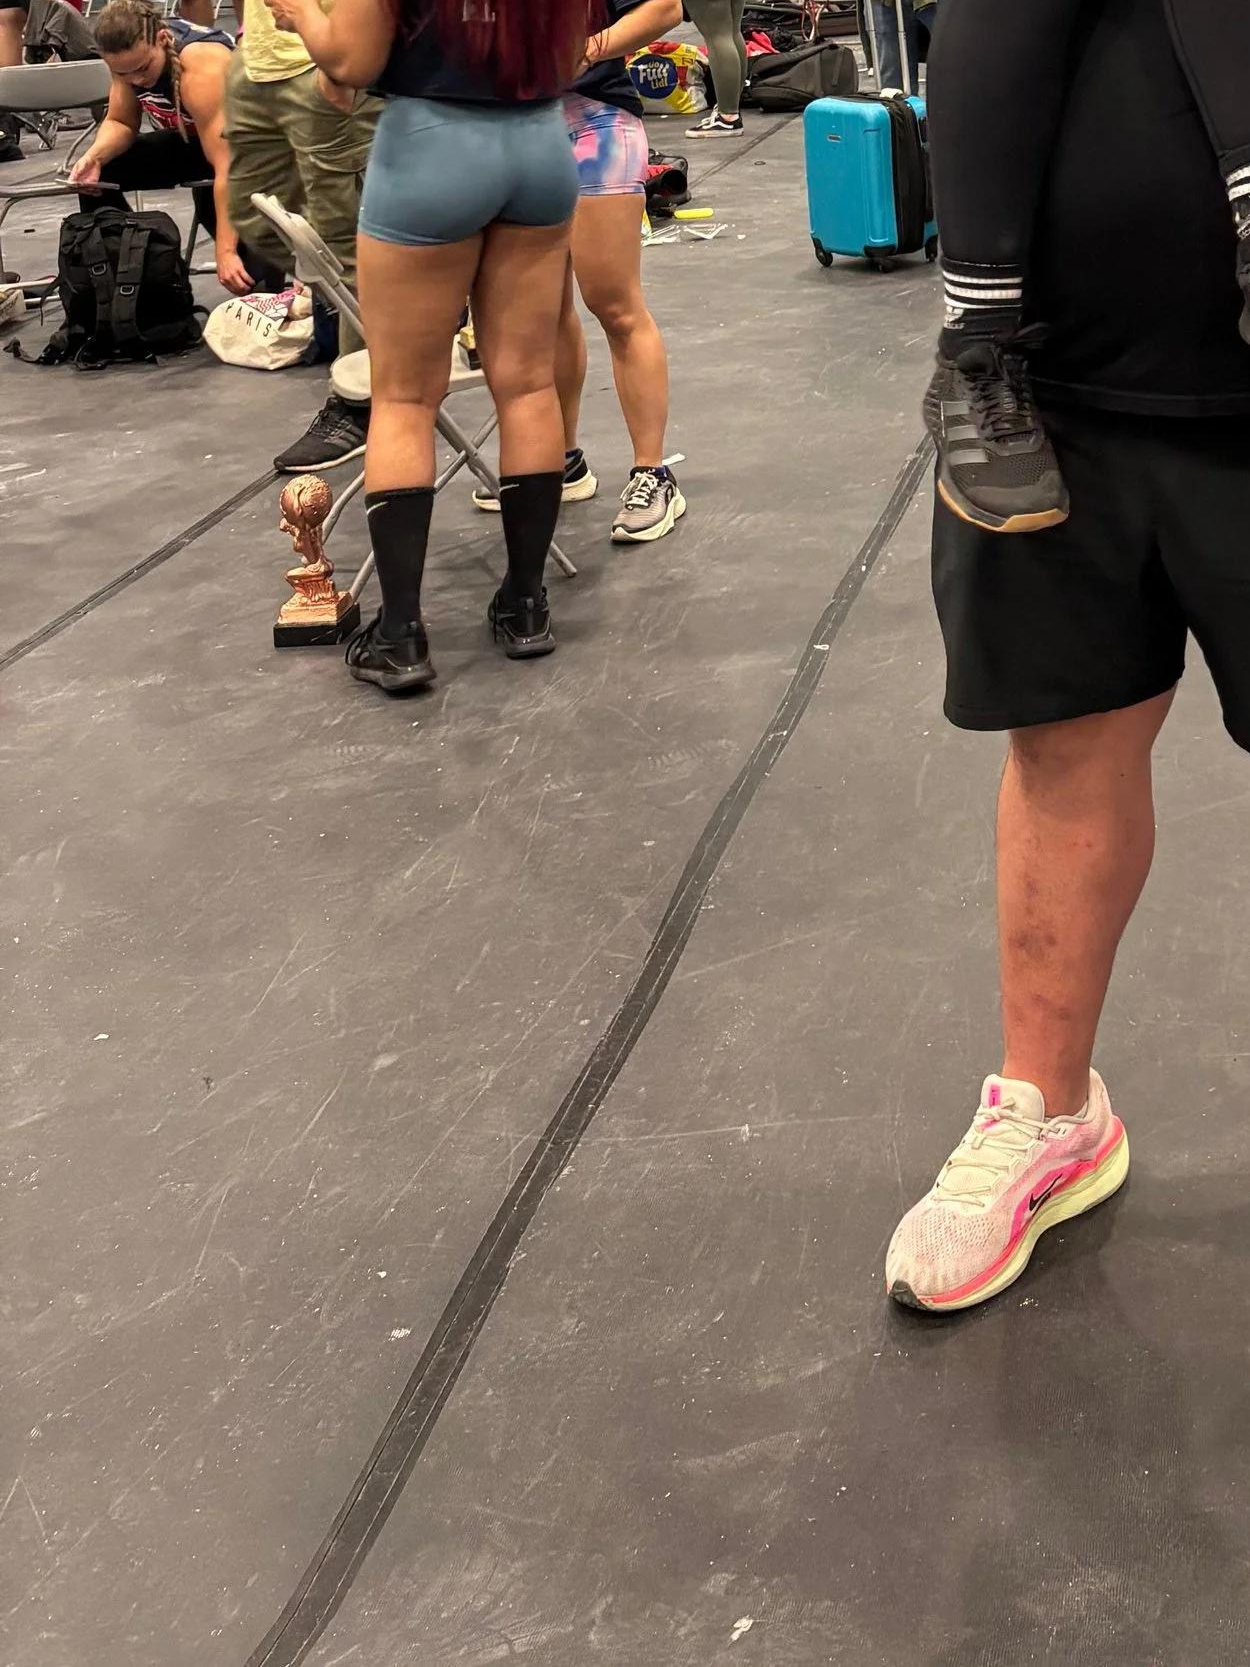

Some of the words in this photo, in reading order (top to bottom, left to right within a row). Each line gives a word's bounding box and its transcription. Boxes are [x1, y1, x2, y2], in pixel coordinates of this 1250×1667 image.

[638, 62, 670, 85] Full
[651, 76, 668, 90] Lidl
[225, 301, 272, 338] PARIS
